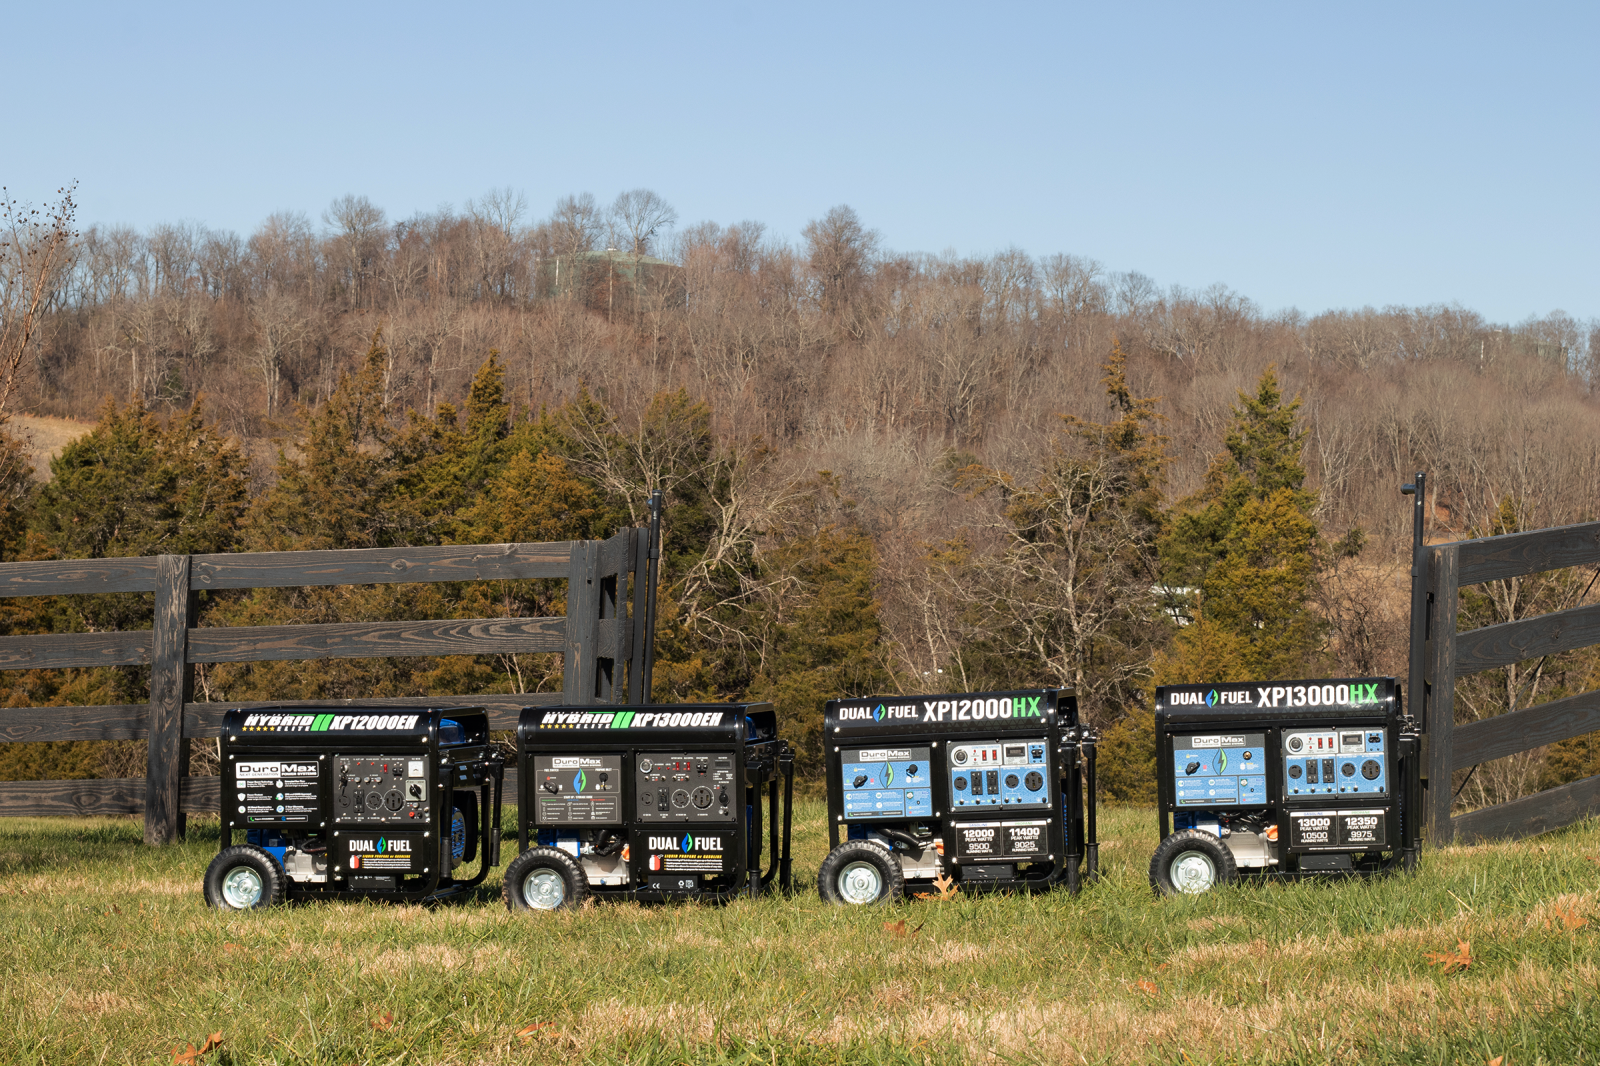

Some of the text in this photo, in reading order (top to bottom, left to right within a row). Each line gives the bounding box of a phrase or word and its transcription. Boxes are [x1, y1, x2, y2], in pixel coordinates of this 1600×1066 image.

[1171, 684, 1378, 708] DUAL FUEL XP13000HX
[839, 697, 1041, 722] DUAL FUEL XP12000HX
[244, 715, 419, 730] HYBRID XP12000EH
[541, 712, 723, 728] HYBRID XP13000EH
[1298, 818, 1330, 827] 13000
[1345, 816, 1378, 826] 12350
[963, 829, 994, 838] 12000
[1009, 827, 1040, 836] 11400
[349, 840, 412, 852] DUAL FUEL
[648, 837, 723, 850] DUAL FUEL
